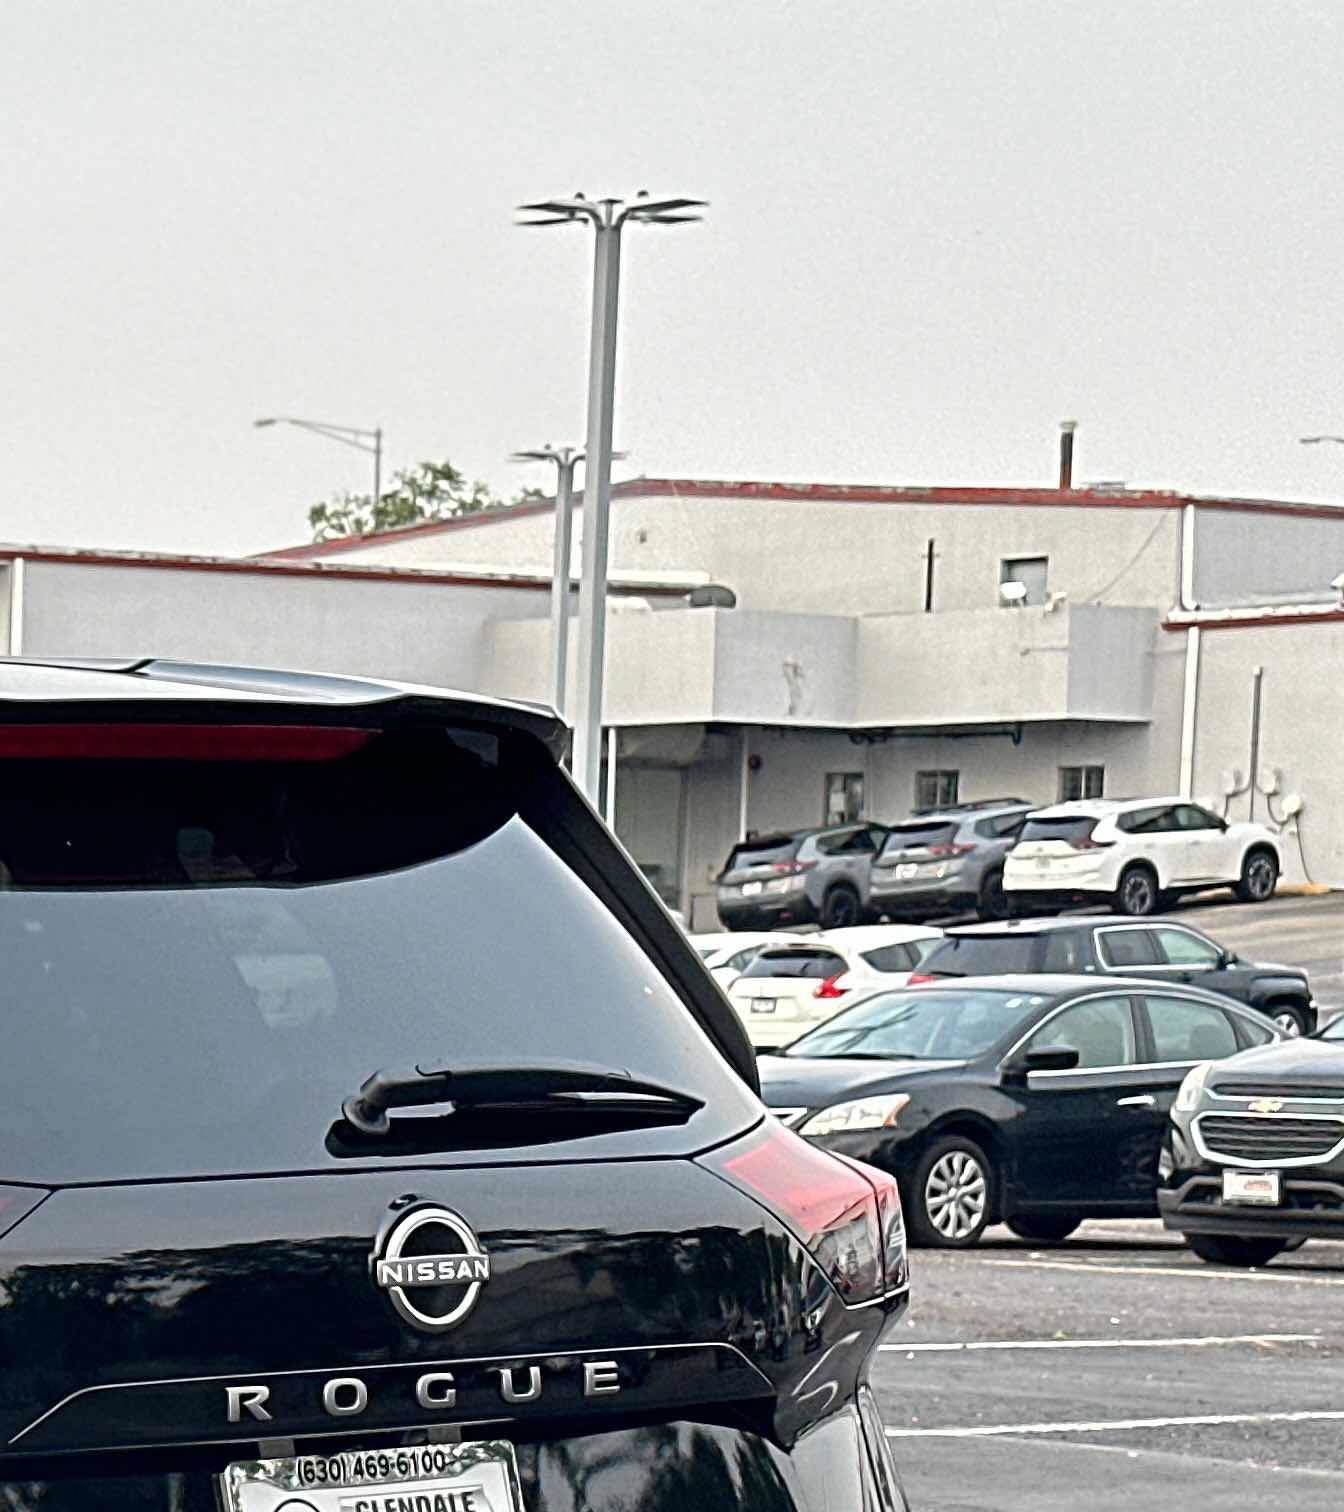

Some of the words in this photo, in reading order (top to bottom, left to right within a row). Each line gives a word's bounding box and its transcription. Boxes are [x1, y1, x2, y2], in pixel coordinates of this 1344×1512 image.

[382, 1260, 489, 1284] NISSAN
[226, 1360, 621, 1422] ROGUE
[297, 1458, 347, 1486] (630)
[353, 1450, 447, 1480] 469-6100
